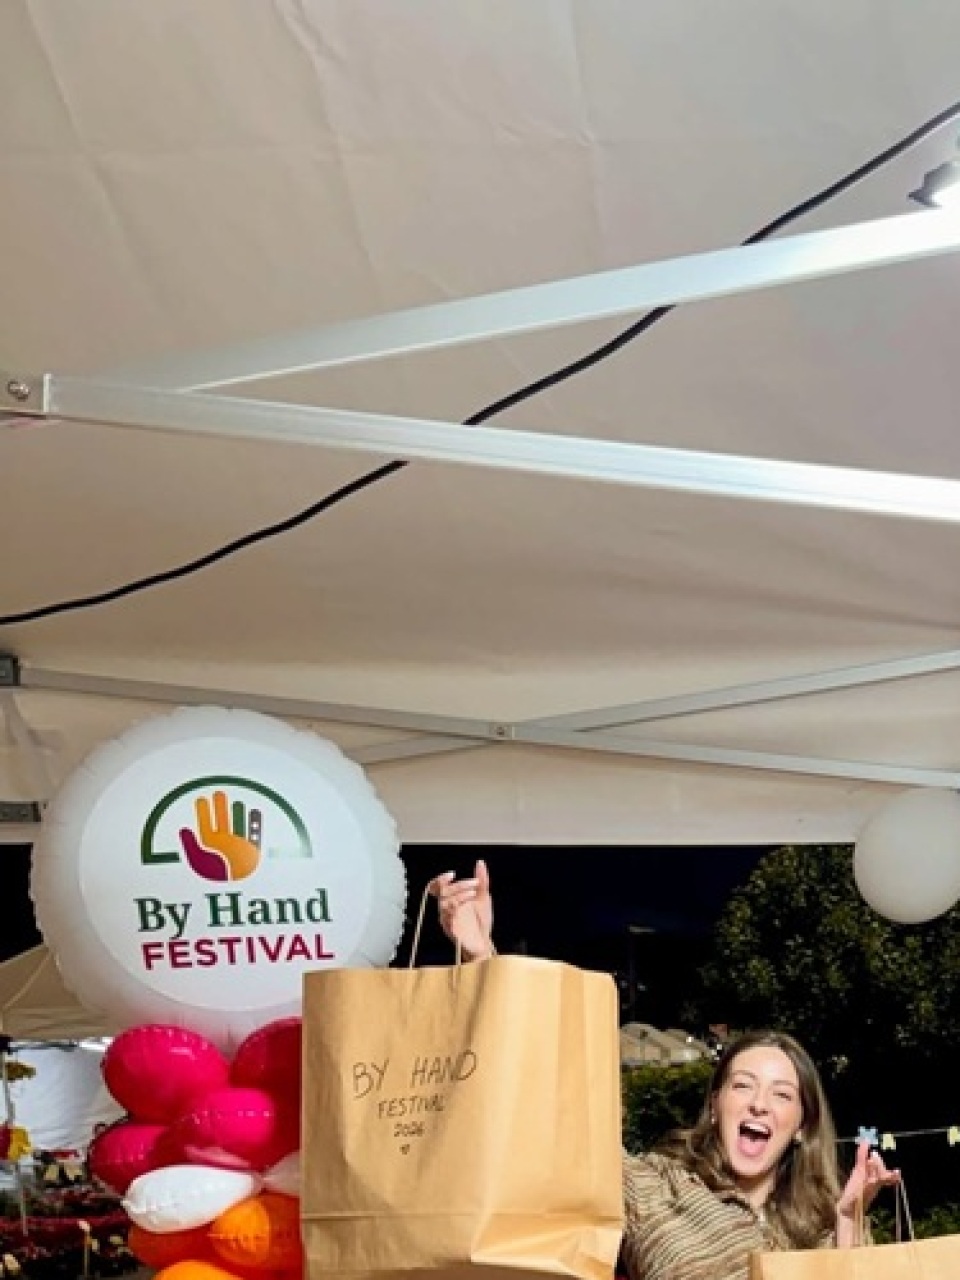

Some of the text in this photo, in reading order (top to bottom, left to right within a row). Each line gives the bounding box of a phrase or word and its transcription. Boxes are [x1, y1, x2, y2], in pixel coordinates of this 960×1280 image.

[133, 888, 333, 940] By Hand
[141, 933, 335, 971] FESTIVAL
[353, 1050, 477, 1099] BY HAND
[378, 1093, 444, 1119] FESTIVAL
[393, 1121, 424, 1137] 2026
